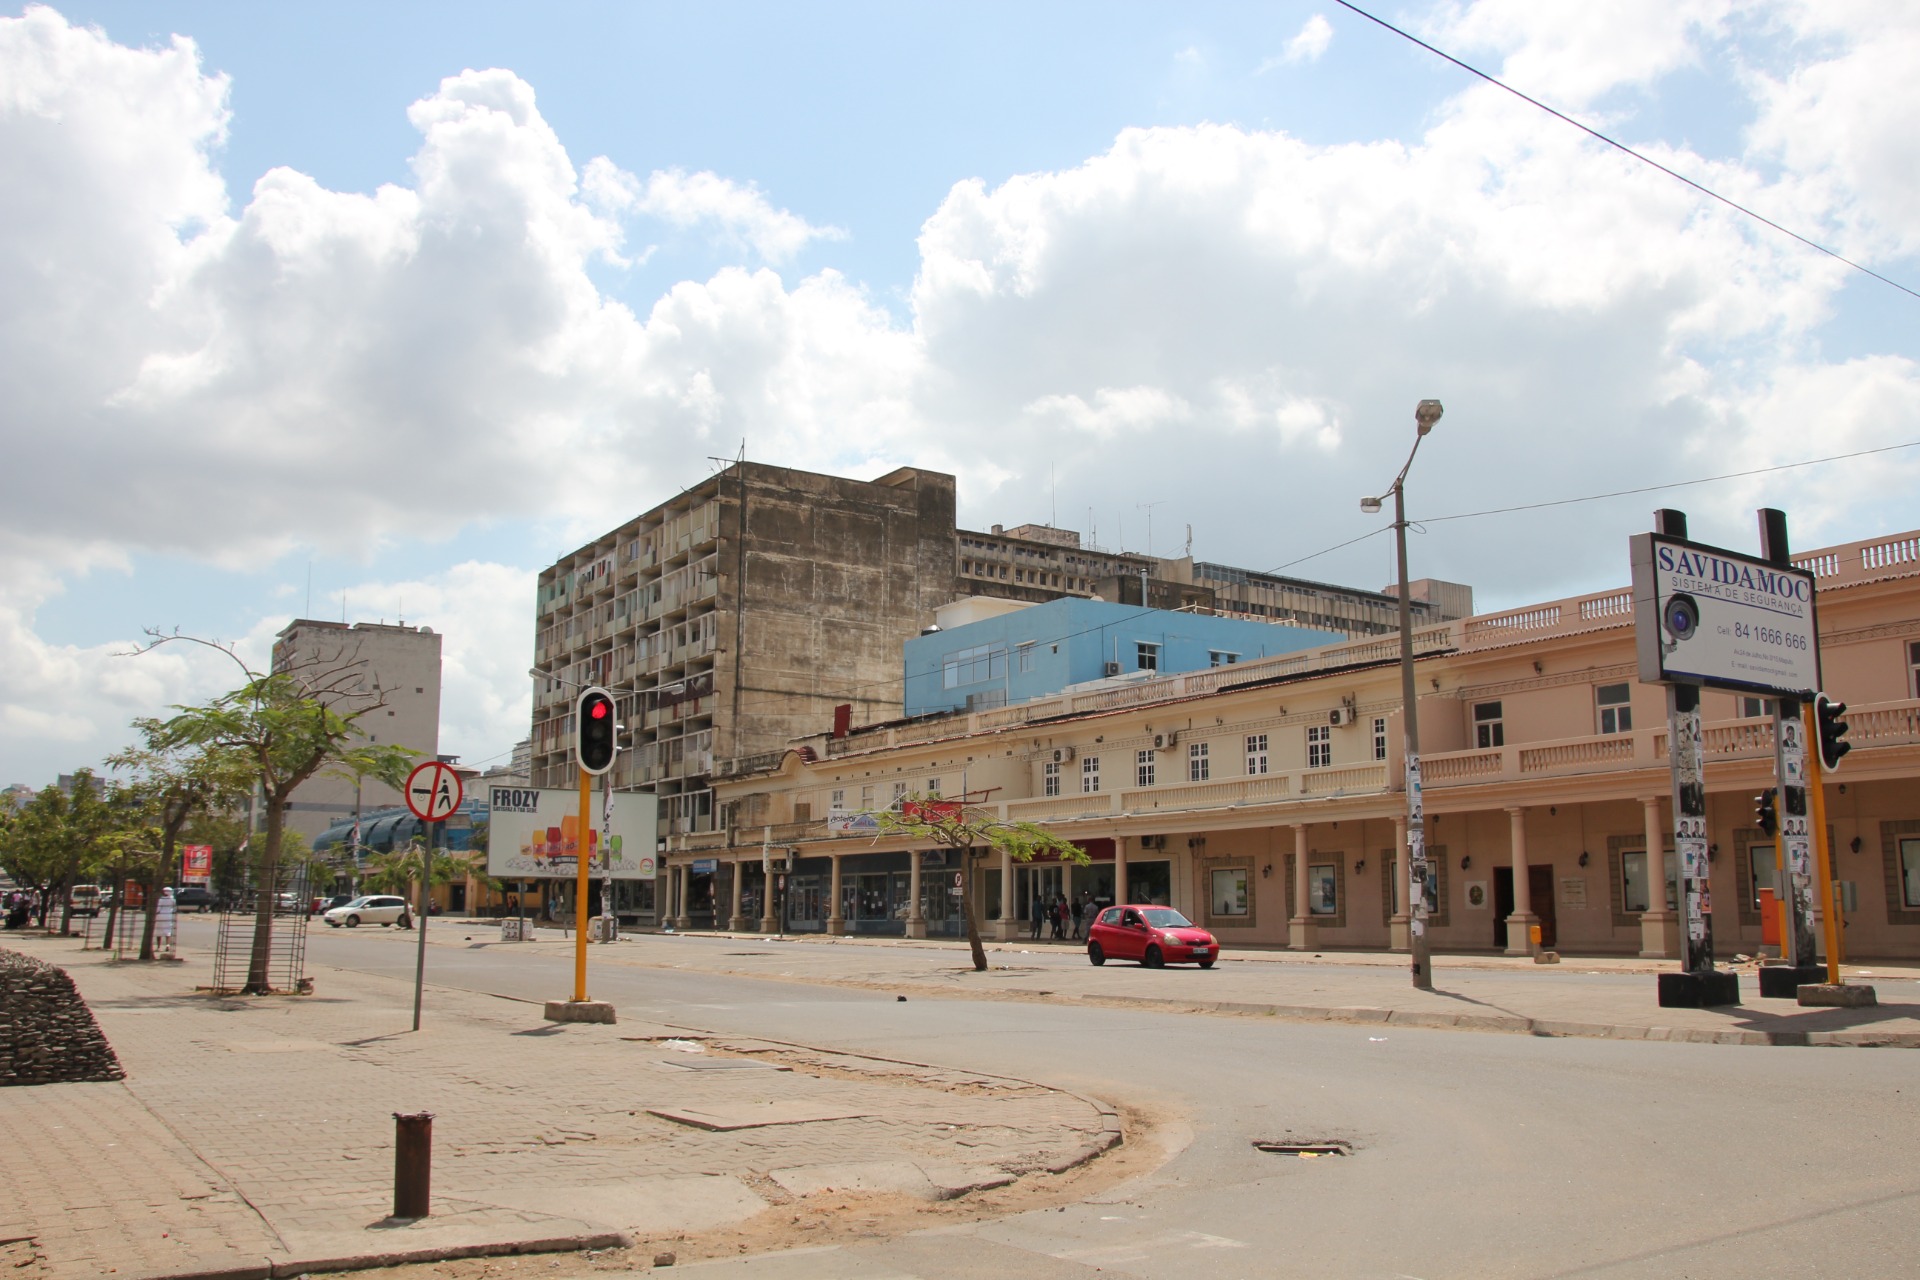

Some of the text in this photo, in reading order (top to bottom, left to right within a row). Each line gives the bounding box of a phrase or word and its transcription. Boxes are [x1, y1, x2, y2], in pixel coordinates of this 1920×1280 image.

[1659, 547, 1809, 602] SAVIDAMOC
[1672, 577, 1803, 613] SISTEMA DE SEGURANÇA
[1734, 621, 1750, 639] 84
[1754, 626, 1782, 646] 1666
[1785, 632, 1807, 651] 666
[493, 790, 539, 807] FROZY
